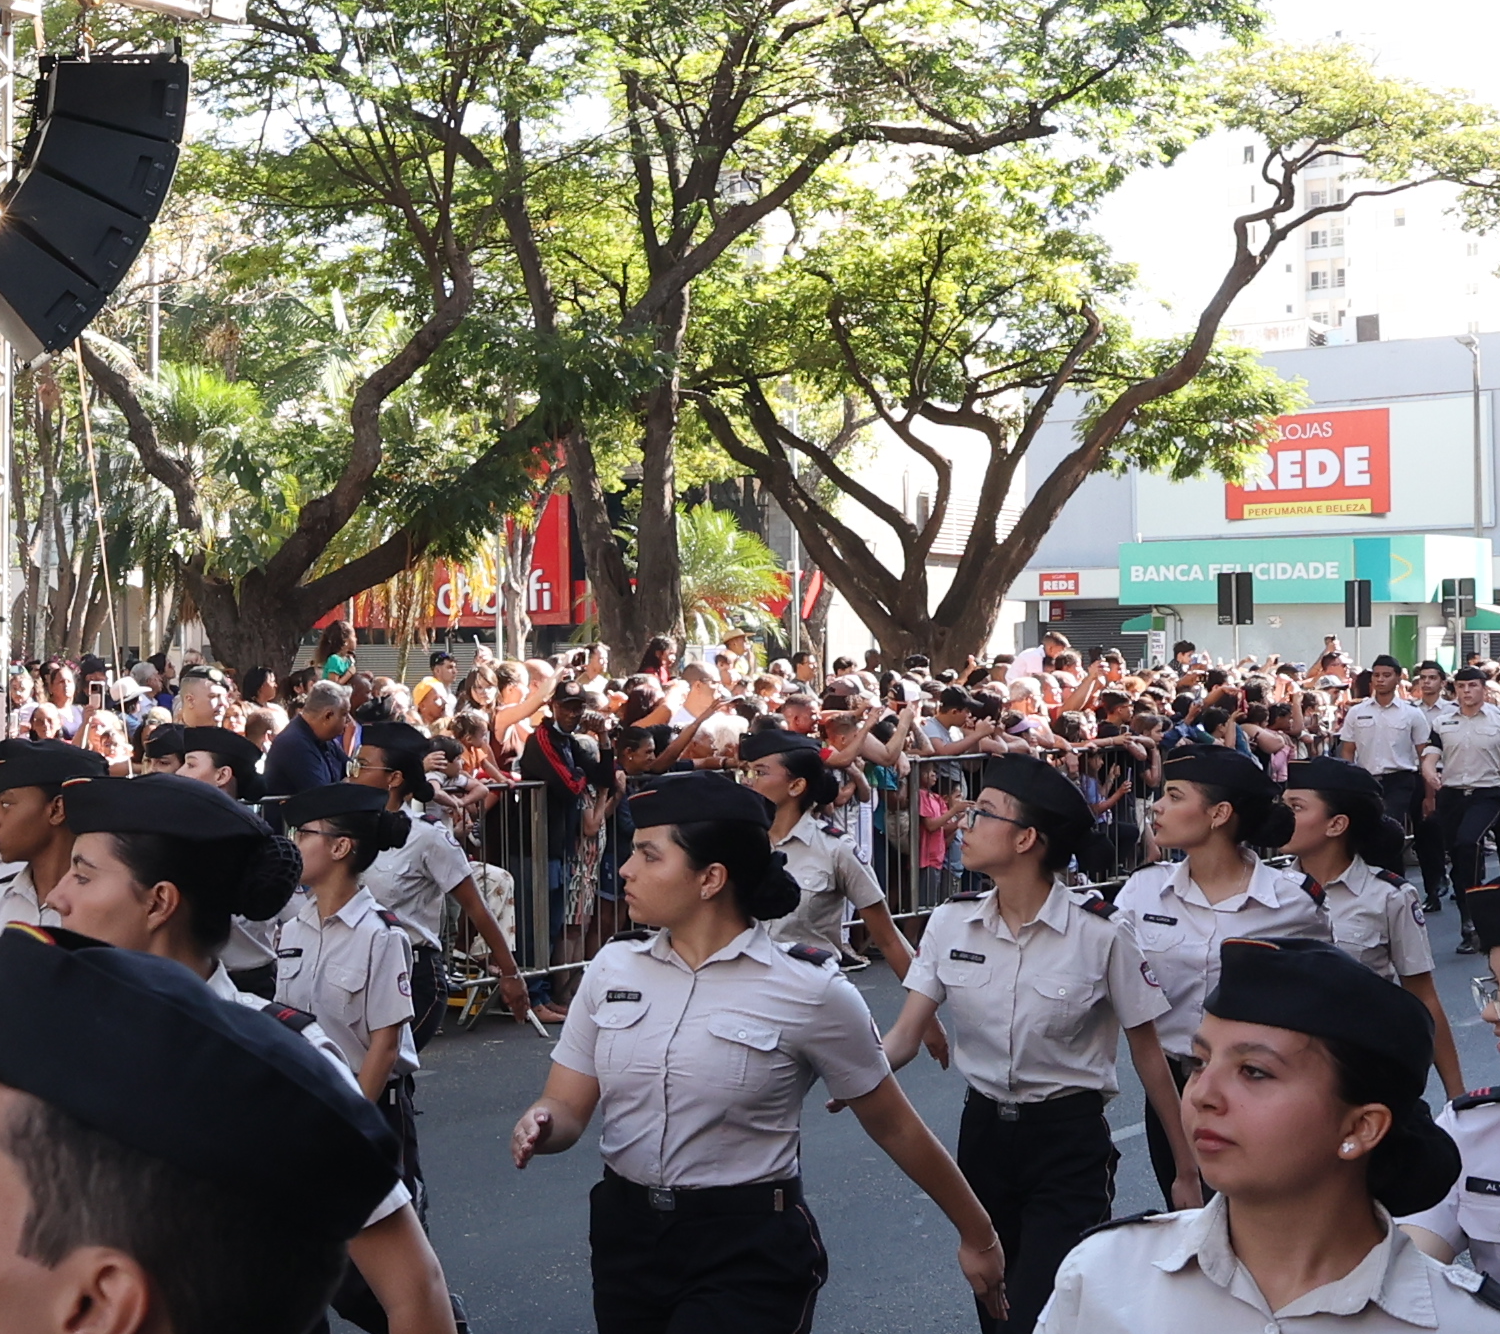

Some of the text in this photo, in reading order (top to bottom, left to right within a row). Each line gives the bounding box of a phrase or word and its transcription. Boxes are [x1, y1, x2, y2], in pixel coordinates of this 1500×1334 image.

[1278, 421, 1333, 440] LOJAS
[1243, 445, 1371, 492] REDE
[1248, 503, 1367, 517] PERFUMARIA E BELEZA
[1130, 564, 1204, 582] BANCA
[1043, 579, 1075, 591] REDE
[1486, 1183, 1497, 1191] AL
